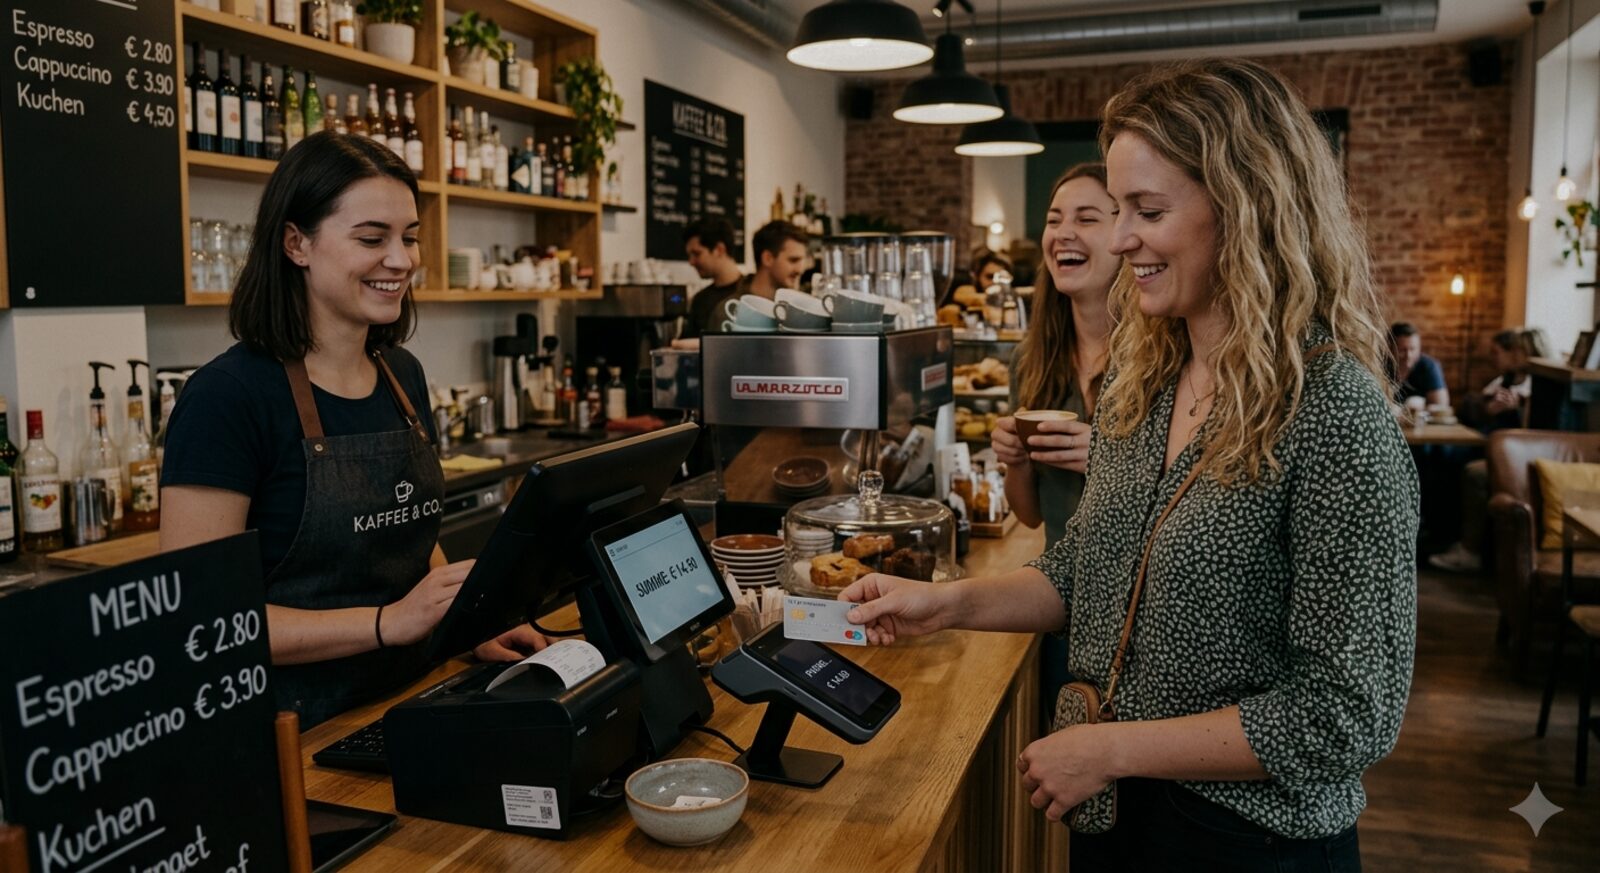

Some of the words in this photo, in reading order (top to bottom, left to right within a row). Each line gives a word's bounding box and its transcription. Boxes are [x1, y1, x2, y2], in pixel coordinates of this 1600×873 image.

[12, 9, 95, 49] Espresso
[124, 35, 138, 58] €
[142, 39, 173, 65] 2.80
[14, 45, 112, 85] Cappuccino
[126, 68, 139, 90] €
[143, 71, 174, 96] 3.90
[17, 81, 85, 116] Kuchen
[127, 100, 140, 123] €
[354, 507, 409, 532] KAFFEE
[412, 504, 420, 520] &
[422, 499, 442, 516] CO.
[90, 571, 181, 636] MENU
[16, 655, 155, 728] Espresso
[184, 624, 208, 662] €
[213, 609, 260, 654] 2.80
[25, 707, 186, 795] Cappuccino
[194, 683, 216, 719] €
[220, 664, 267, 710] 3.90
[38, 797, 156, 873] Kuchen
